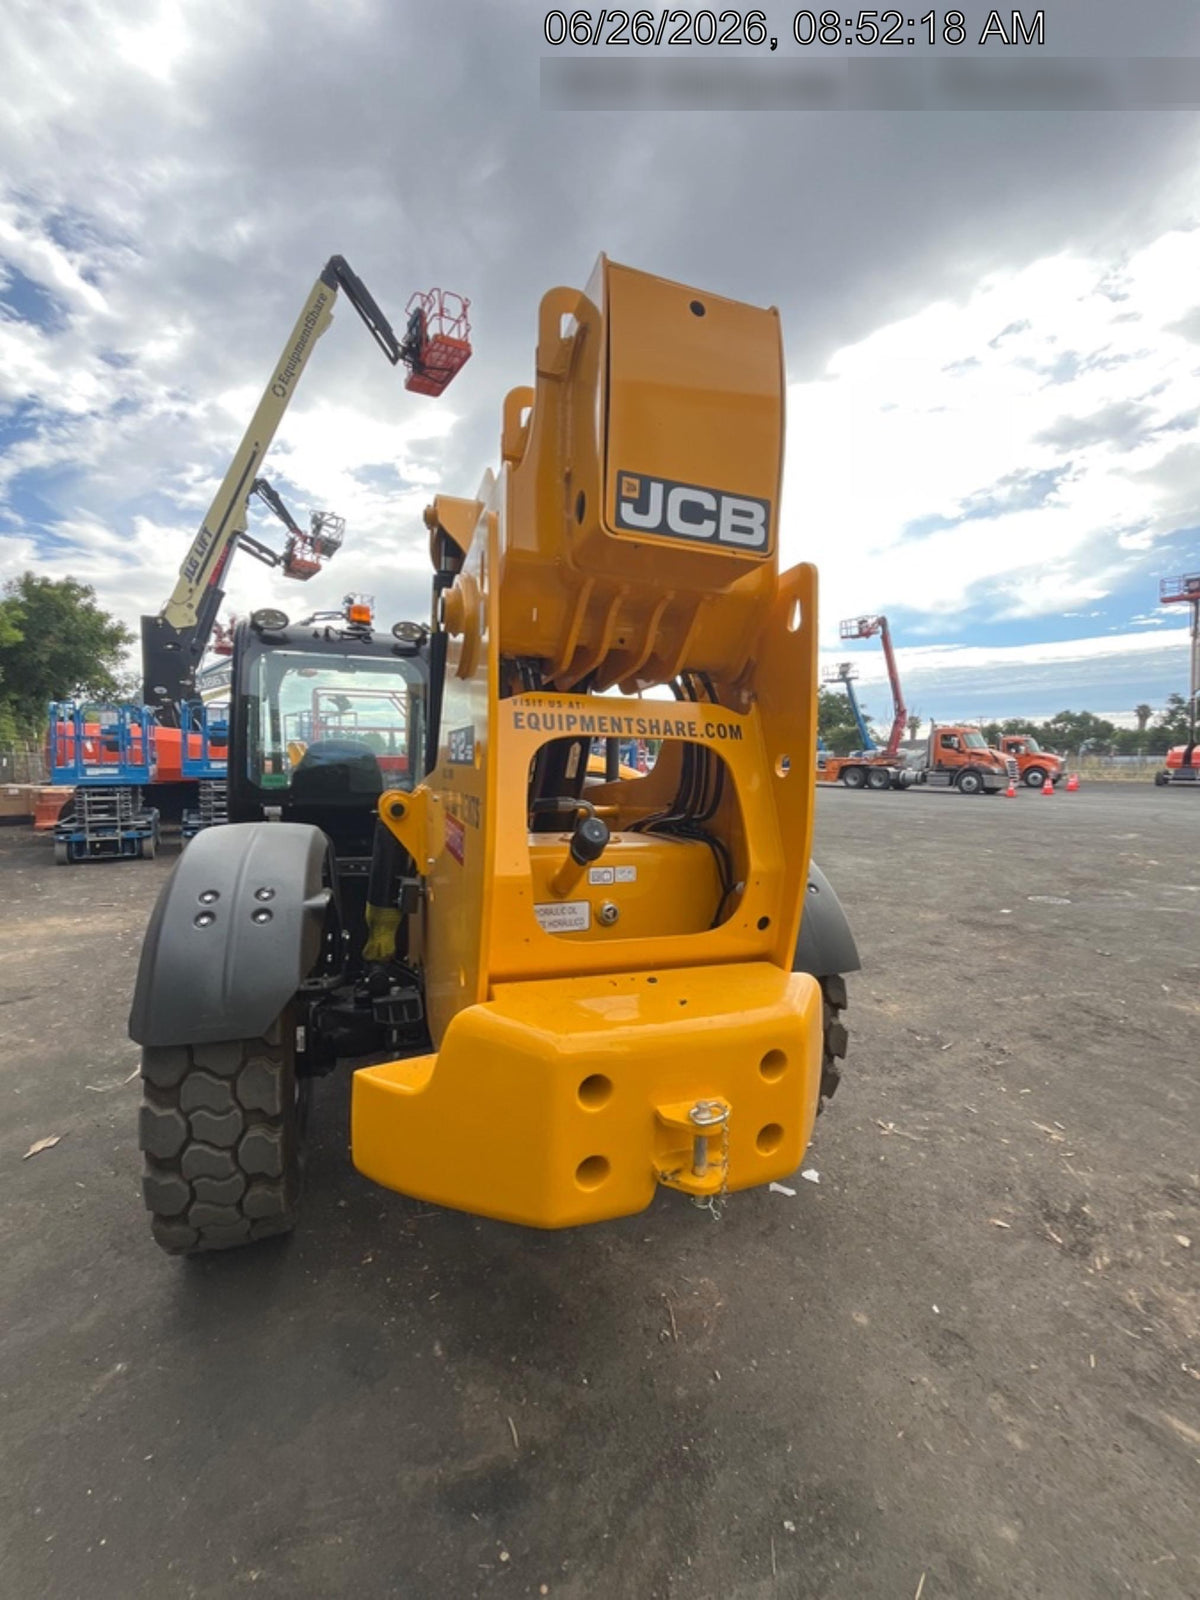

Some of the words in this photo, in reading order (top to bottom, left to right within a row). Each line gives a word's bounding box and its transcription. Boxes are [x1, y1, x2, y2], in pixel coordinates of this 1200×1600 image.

[278, 292, 328, 386] EquipmentShare
[620, 481, 766, 547] JCB
[184, 557, 200, 583] JLG
[195, 526, 213, 558] LIFT
[512, 698, 543, 708] VISIT
[549, 700, 563, 709] US
[513, 711, 744, 741] EQUIPMENTSHARE.COM
